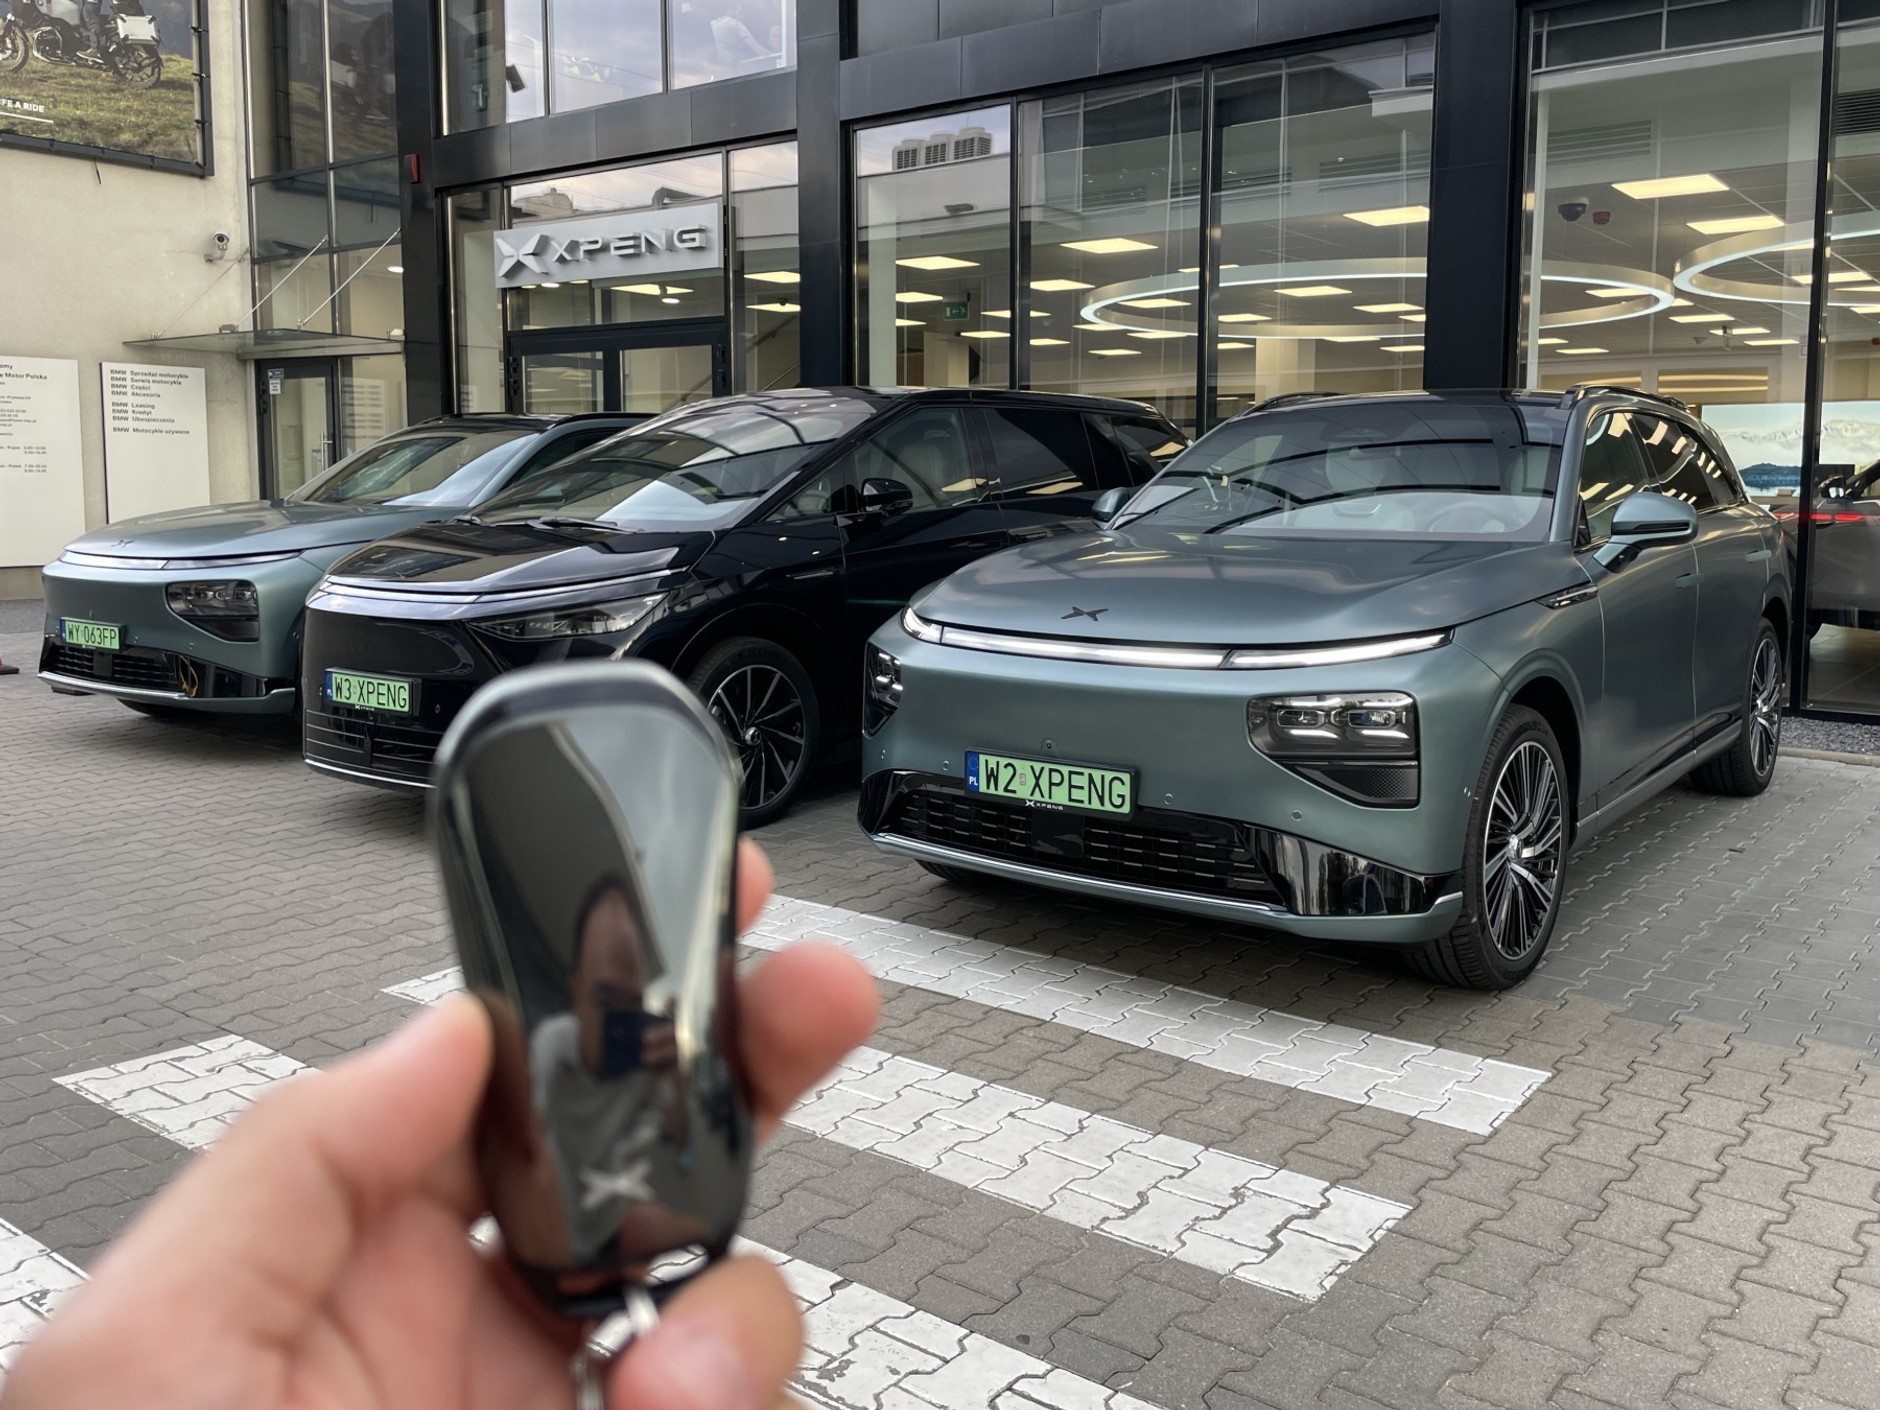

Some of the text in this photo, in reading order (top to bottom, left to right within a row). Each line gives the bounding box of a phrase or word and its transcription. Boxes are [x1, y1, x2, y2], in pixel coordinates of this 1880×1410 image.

[15, 101, 21, 109] A
[23, 103, 44, 113] RIDE
[552, 225, 706, 263] XPENG
[67, 623, 117, 646] WY 063FP
[335, 677, 351, 700] W3
[358, 680, 407, 708] XPENG
[969, 759, 1125, 809] PL W2 XPENG
